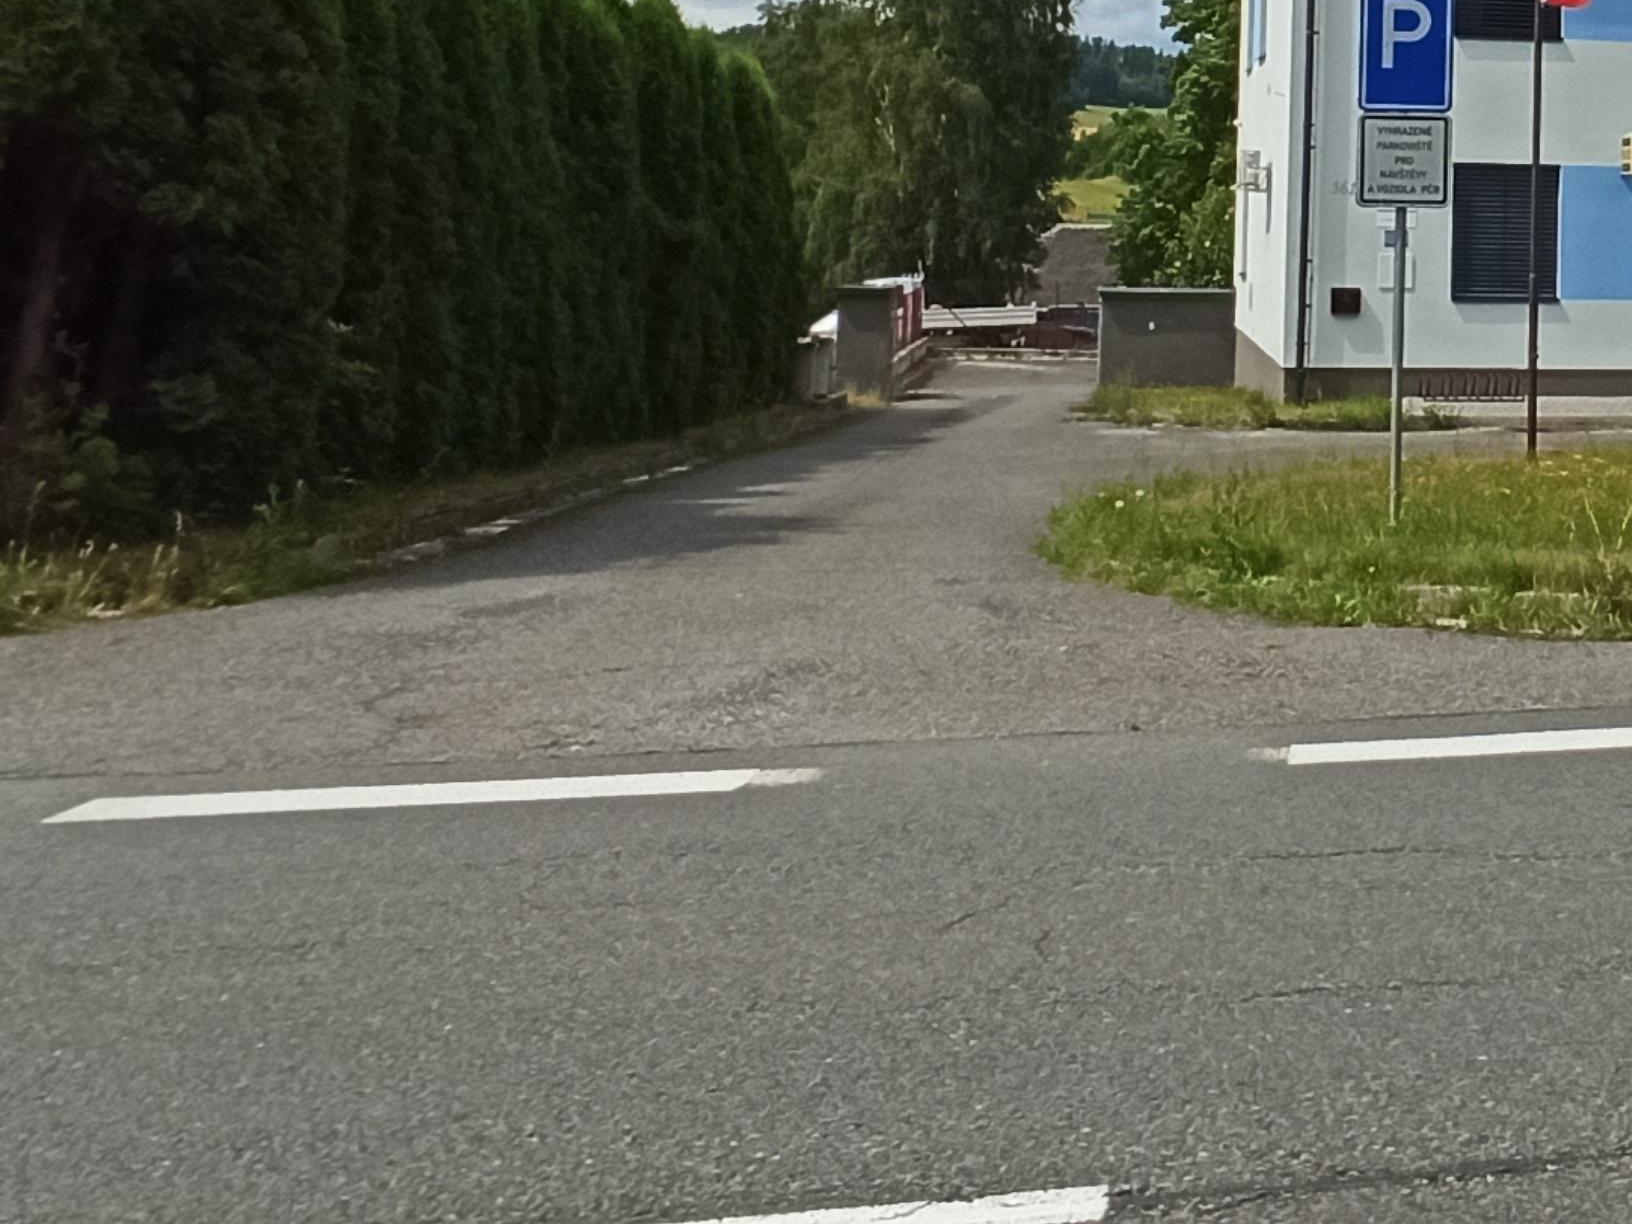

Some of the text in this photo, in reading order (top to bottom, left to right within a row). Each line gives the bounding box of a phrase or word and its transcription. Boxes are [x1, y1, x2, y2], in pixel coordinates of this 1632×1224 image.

[1381, 0, 1432, 69] P
[1376, 126, 1432, 136] VYHRAZENÉ
[1395, 156, 1415, 165] PRO
[1367, 184, 1375, 194] A
[1421, 183, 1440, 194] PČR
